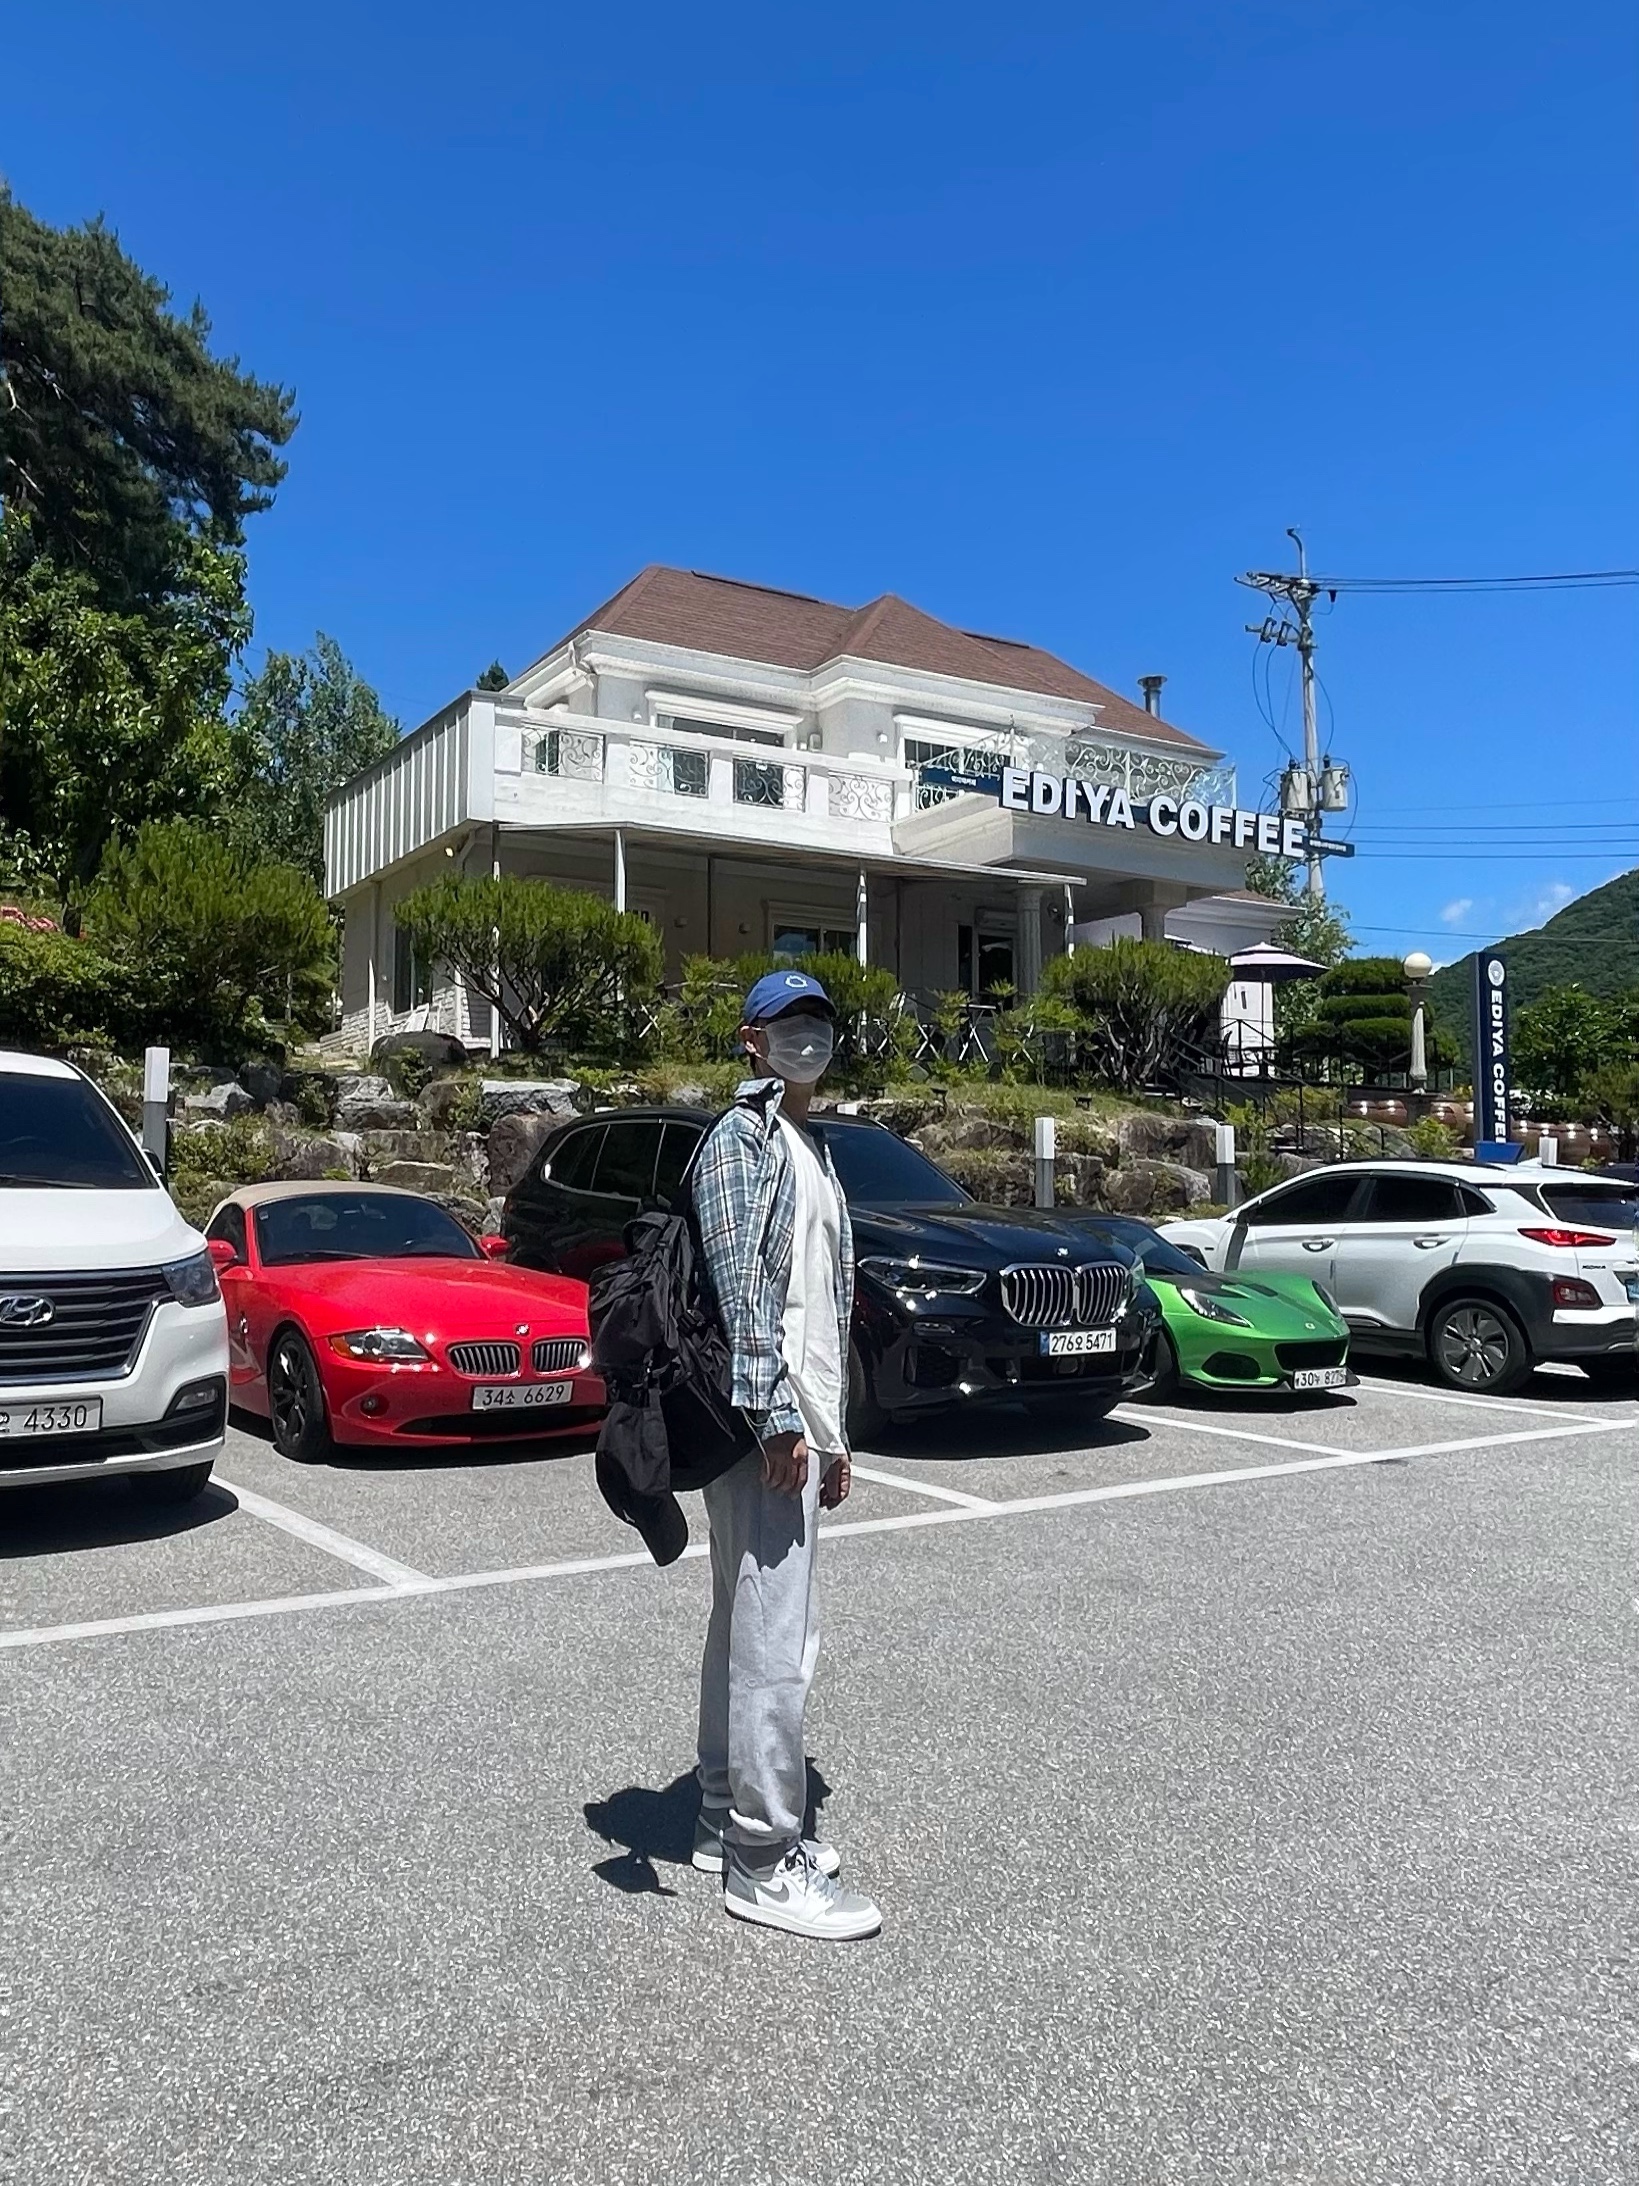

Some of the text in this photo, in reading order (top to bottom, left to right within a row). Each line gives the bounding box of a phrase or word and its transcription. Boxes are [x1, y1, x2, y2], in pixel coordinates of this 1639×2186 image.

[1002, 767, 1306, 858] EDIYA COFFEE
[1491, 989, 1504, 1057] EDIYA
[1051, 1332, 1113, 1353] 276오 5471
[482, 1385, 565, 1406] 34소 6629
[24, 1405, 87, 1432] 4330
